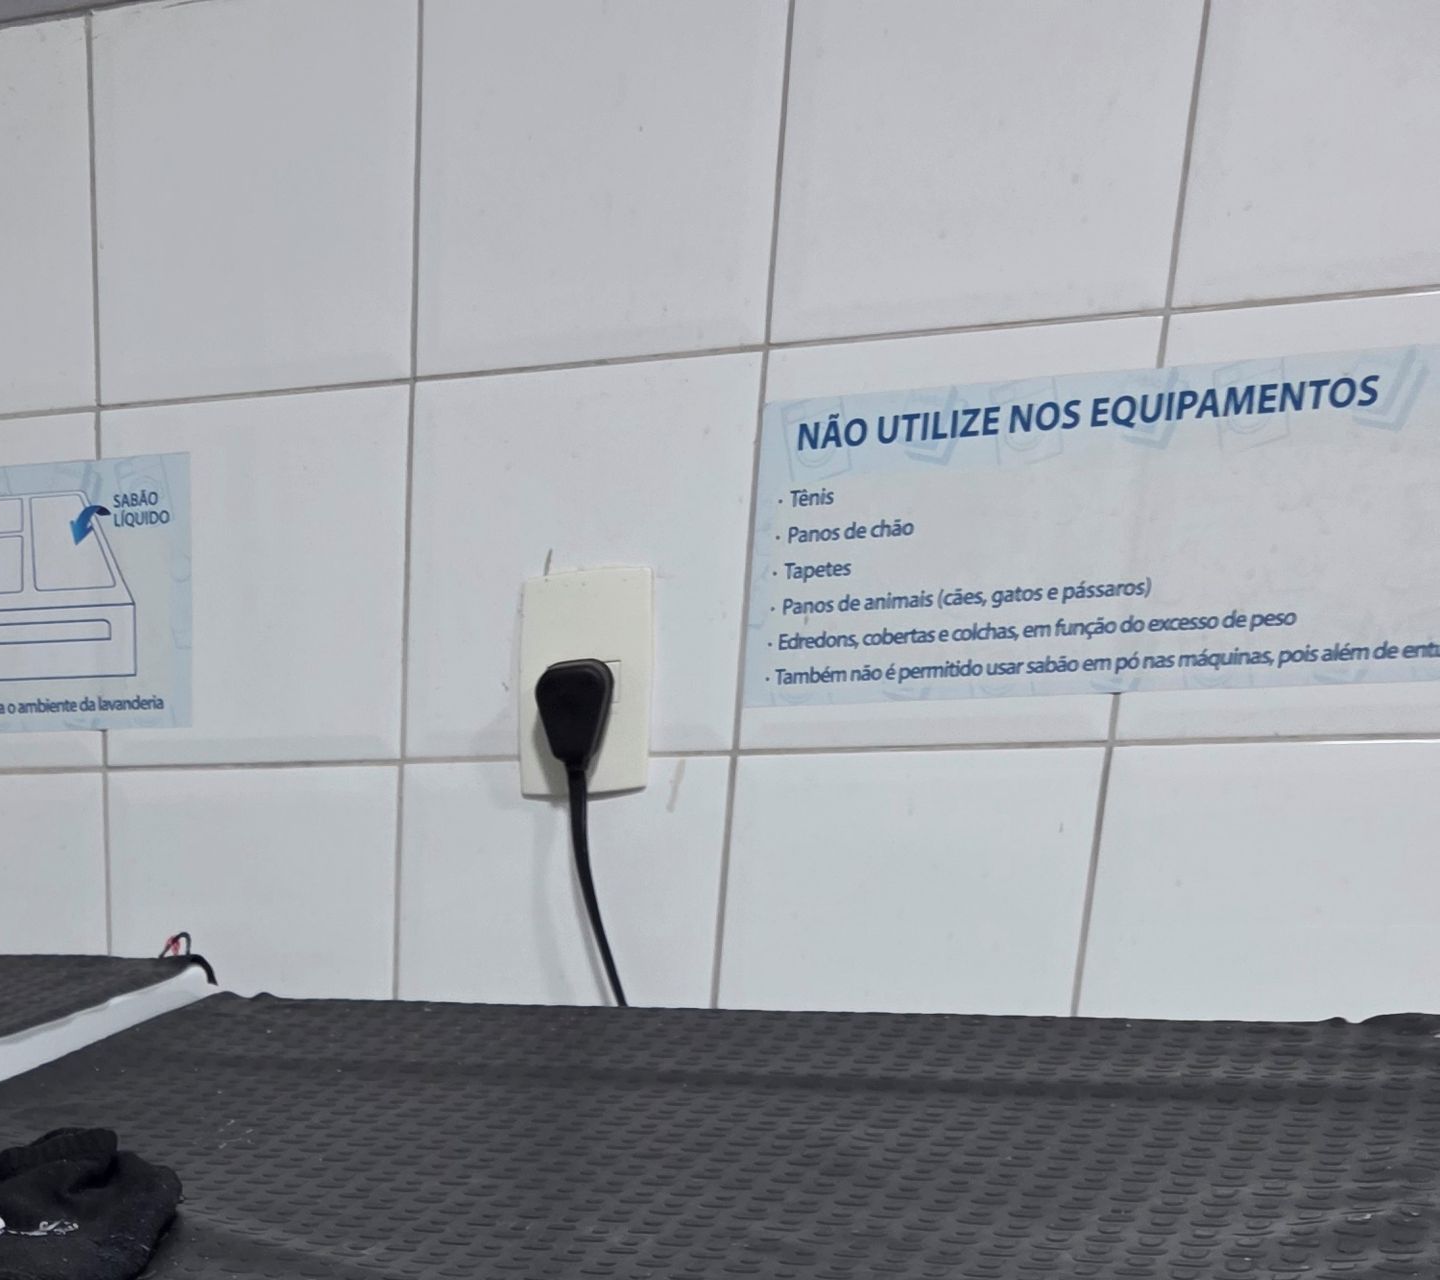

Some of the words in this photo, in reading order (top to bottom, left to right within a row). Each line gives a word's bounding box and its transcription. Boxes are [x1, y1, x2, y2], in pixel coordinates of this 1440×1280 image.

[797, 413, 868, 451] NÃO
[877, 405, 1001, 444] UTILIZE
[1008, 398, 1081, 433] NOS
[1090, 374, 1380, 427] EQUIPAMENTOS
[112, 489, 158, 508] SABÃO
[789, 487, 834, 507] Tênis
[113, 509, 170, 528] LÍQUIDO
[787, 525, 840, 544] Panos
[843, 521, 867, 540] de
[869, 518, 914, 538] chão
[783, 561, 852, 583] Tapetes
[782, 597, 834, 615] Panos
[837, 593, 861, 612] de
[863, 589, 933, 611] animais
[936, 587, 987, 609] (cães,
[990, 585, 1043, 608] gatos
[1046, 586, 1058, 600] e
[1061, 576, 1152, 604] pássaros)
[777, 630, 859, 650] Edredons,
[861, 626, 936, 646] cobertas
[937, 628, 949, 642] e
[951, 621, 1019, 642] colchas,
[1021, 623, 1051, 638] em
[1054, 616, 1117, 640] função
[1119, 614, 1145, 633] do
[1146, 615, 1219, 632] excesso
[1221, 609, 1247, 629] de
[1248, 611, 1297, 632] peso
[774, 665, 847, 685] Também
[849, 663, 883, 682] não
[884, 662, 896, 680] é
[897, 658, 983, 684] permitido
[985, 660, 1024, 676] usar
[1025, 654, 1079, 674] sabão
[1081, 657, 1112, 672] em
[1113, 650, 1140, 675] pó
[1141, 654, 1175, 669] nas
[1177, 648, 1275, 671] máquinas,
[1276, 646, 1319, 669] pois
[1319, 642, 1370, 662] além
[1371, 640, 1400, 660] de
